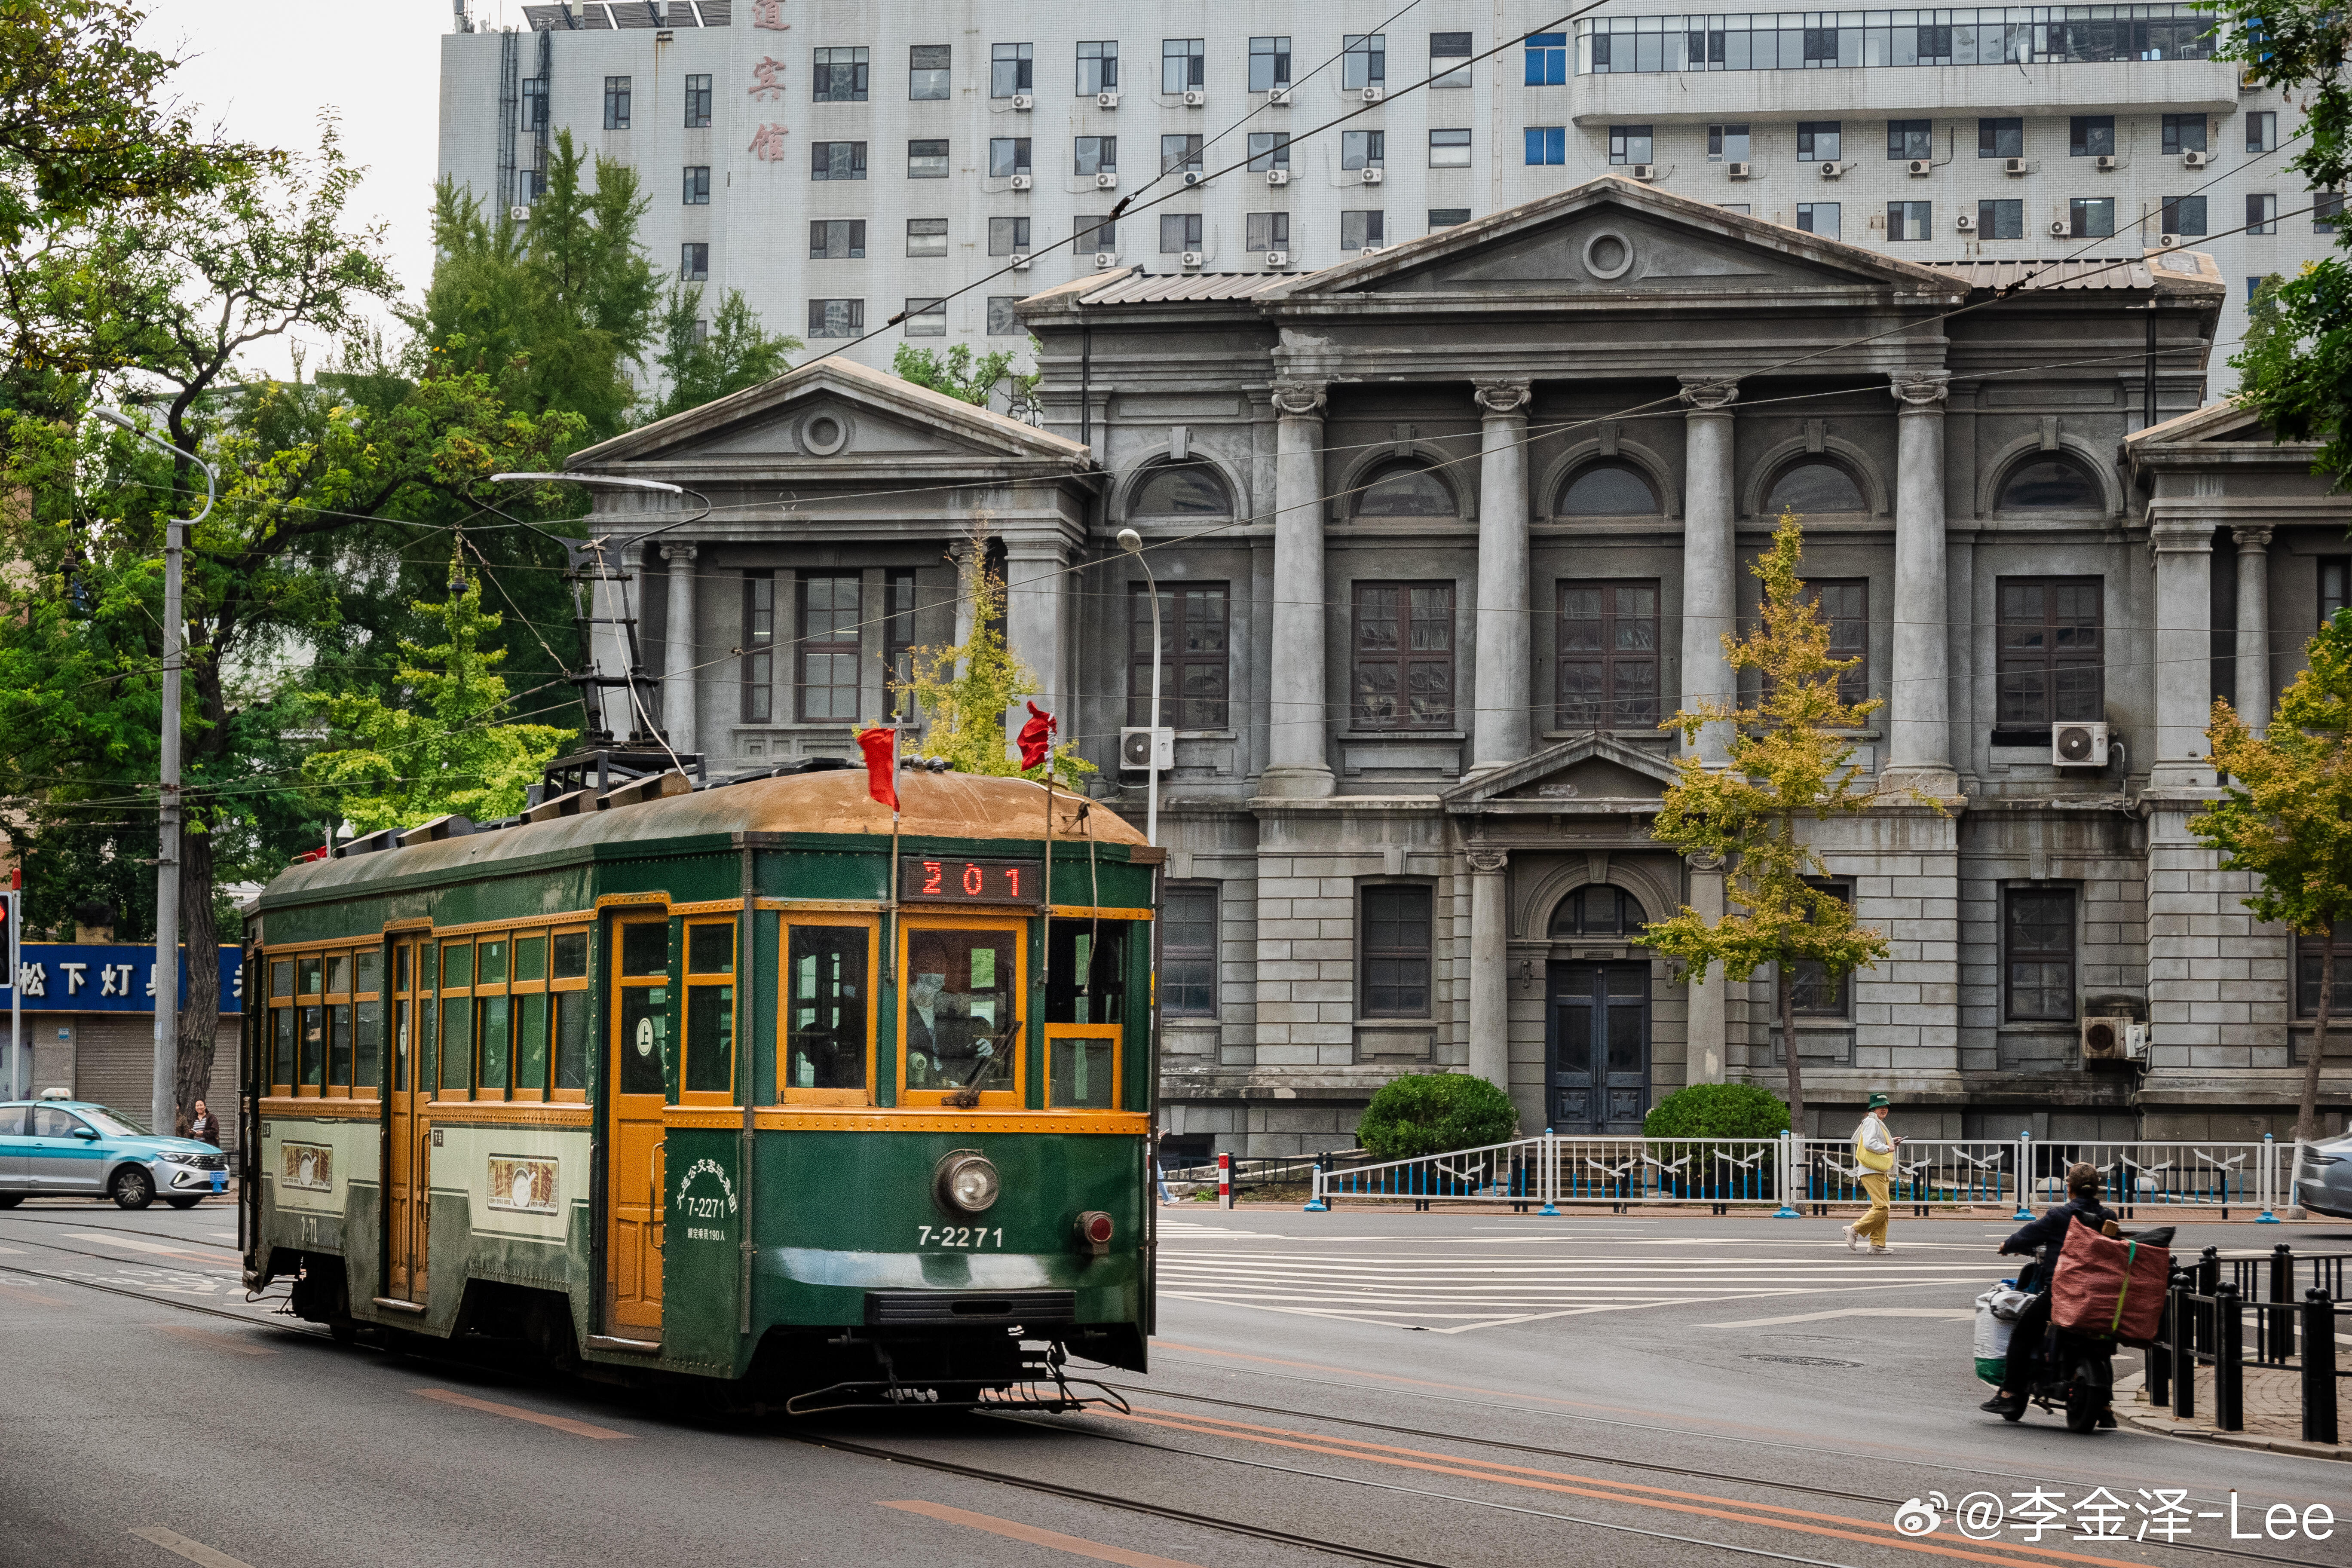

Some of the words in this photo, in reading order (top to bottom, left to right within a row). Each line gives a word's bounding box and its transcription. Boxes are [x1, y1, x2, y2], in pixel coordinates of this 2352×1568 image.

[922, 861, 1019, 897] 201
[641, 1026, 649, 1045] 上
[688, 1197, 724, 1219] 7-2271
[918, 1225, 1003, 1248] 7-2271
